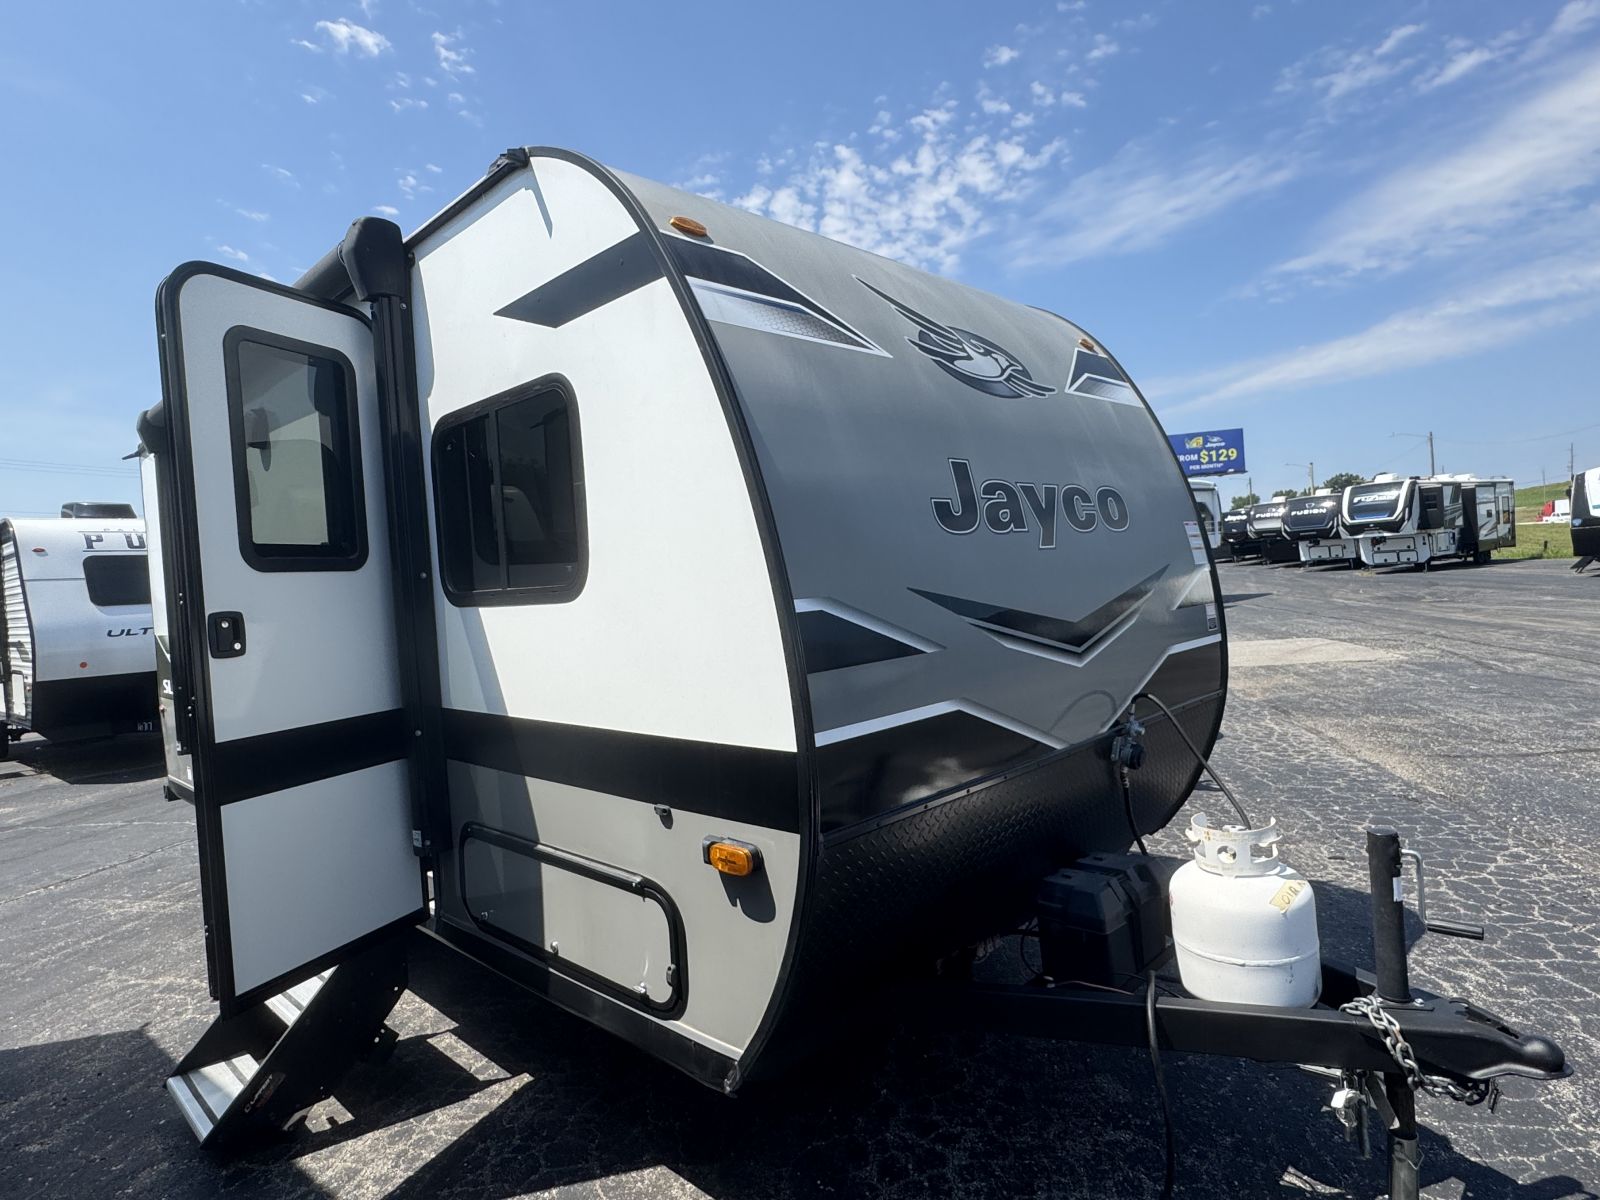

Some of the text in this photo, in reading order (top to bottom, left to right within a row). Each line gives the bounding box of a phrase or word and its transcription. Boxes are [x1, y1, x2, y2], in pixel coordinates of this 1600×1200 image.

[1177, 448, 1238, 463] ROM $129
[930, 457, 1130, 550] Jayco
